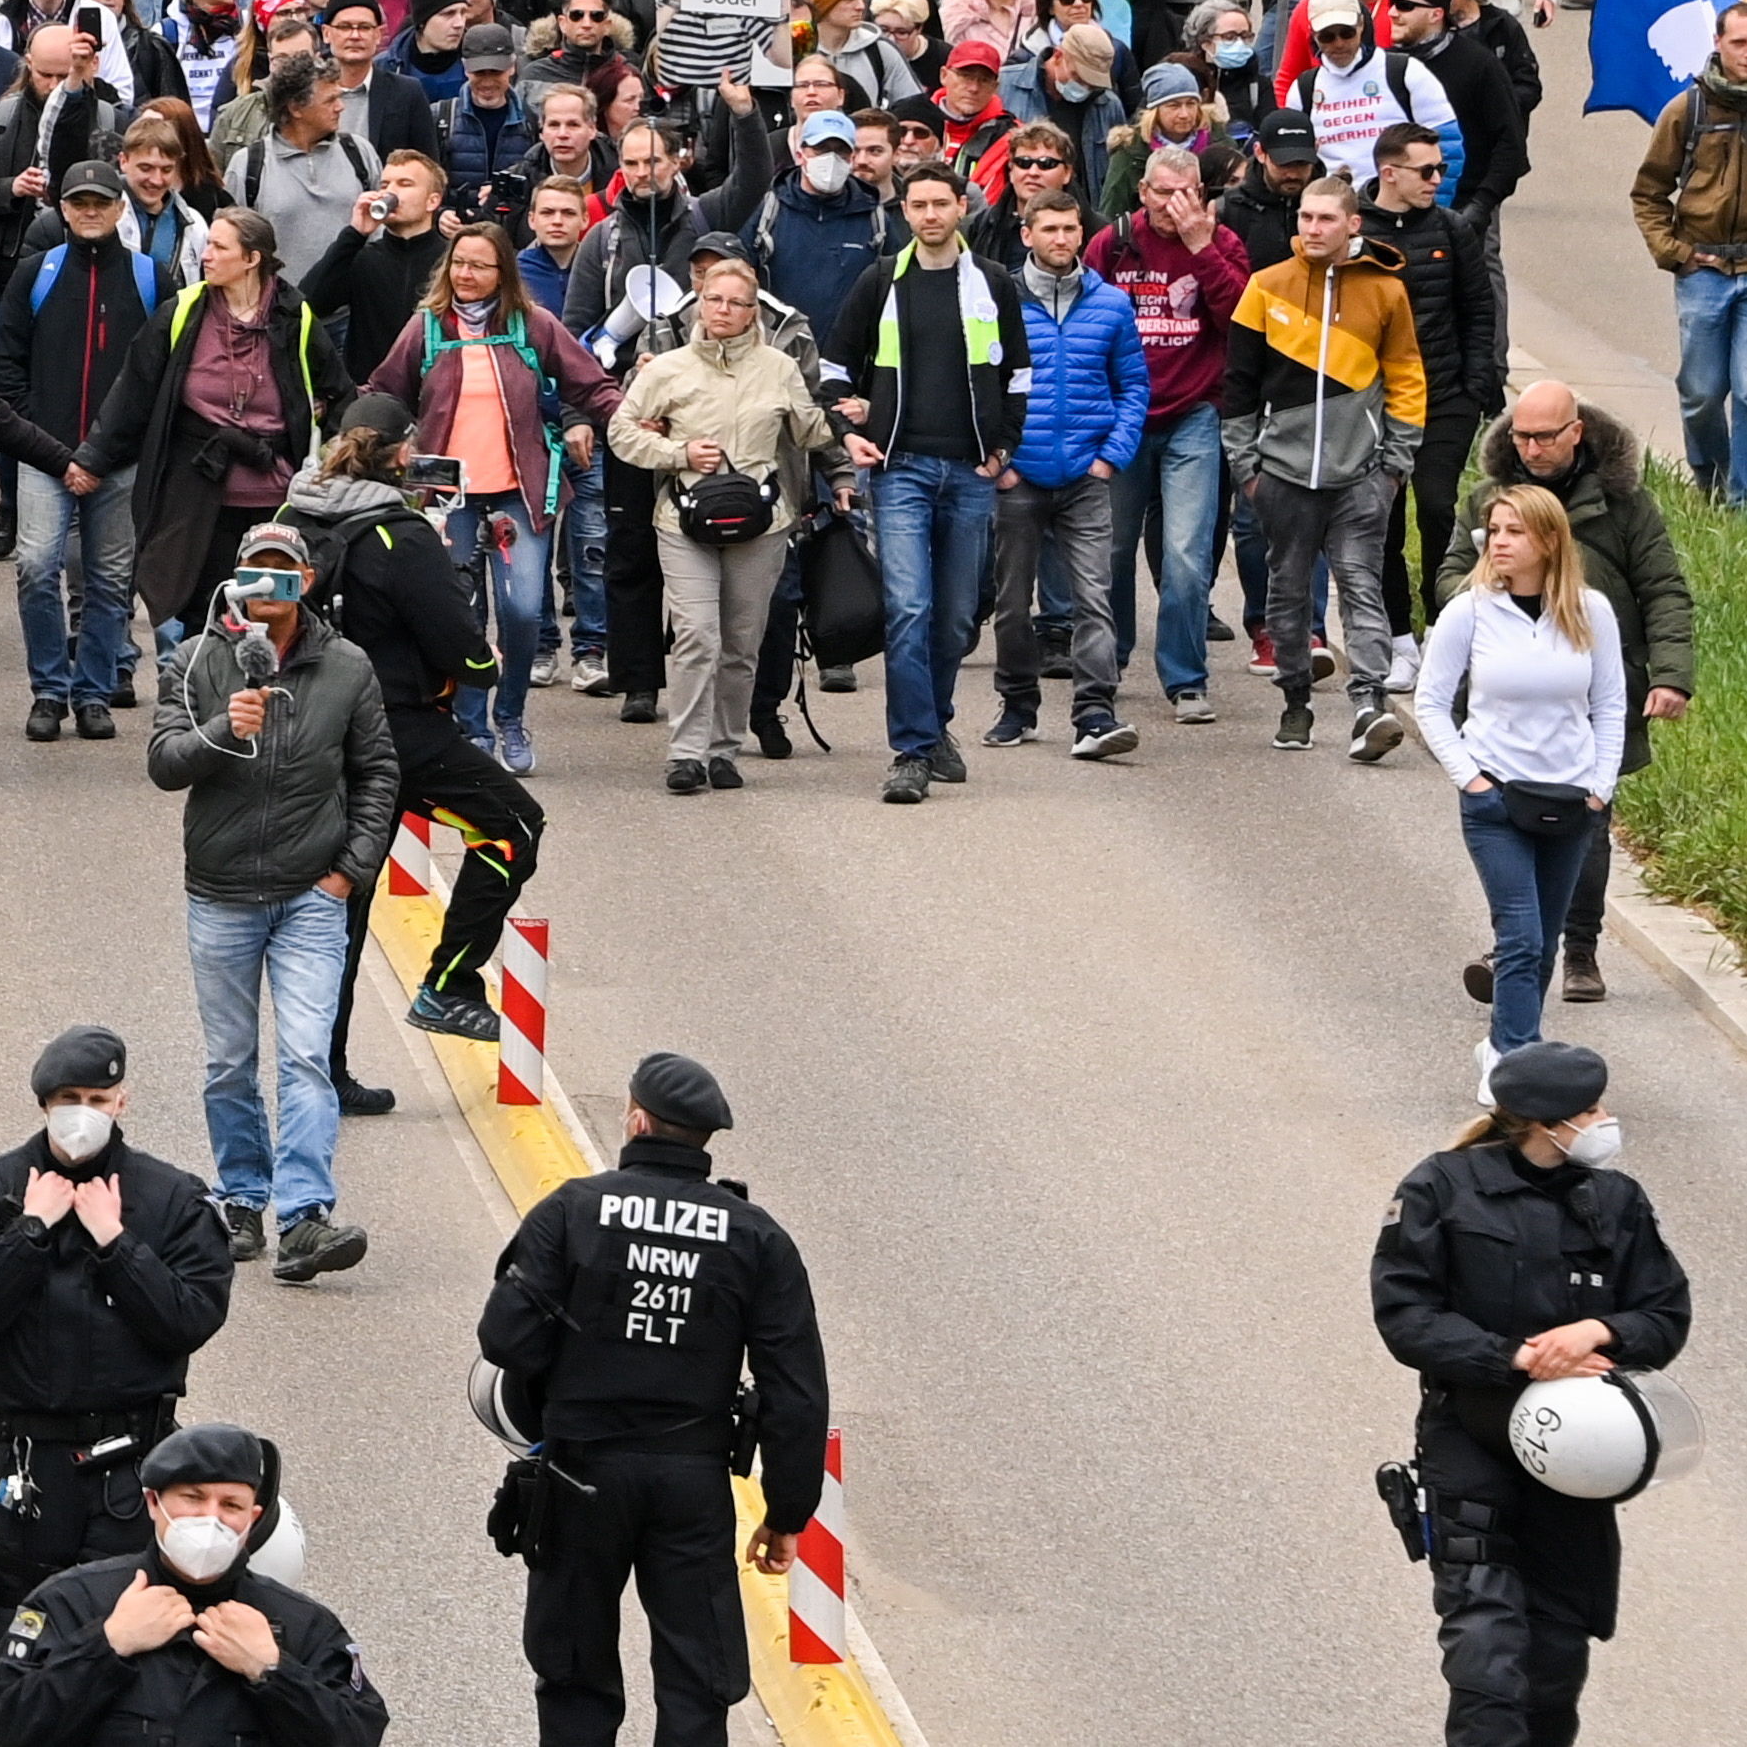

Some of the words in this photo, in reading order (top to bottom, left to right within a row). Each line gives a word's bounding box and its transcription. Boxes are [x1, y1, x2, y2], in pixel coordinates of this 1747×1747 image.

[1322, 111, 1376, 129] GEGEN
[599, 1193, 730, 1243] POLIZEI
[626, 1242, 700, 1279] NRW
[631, 1280, 692, 1314] 2611
[626, 1312, 686, 1345] FLT
[1522, 1406, 1562, 1475] 6-1-2
